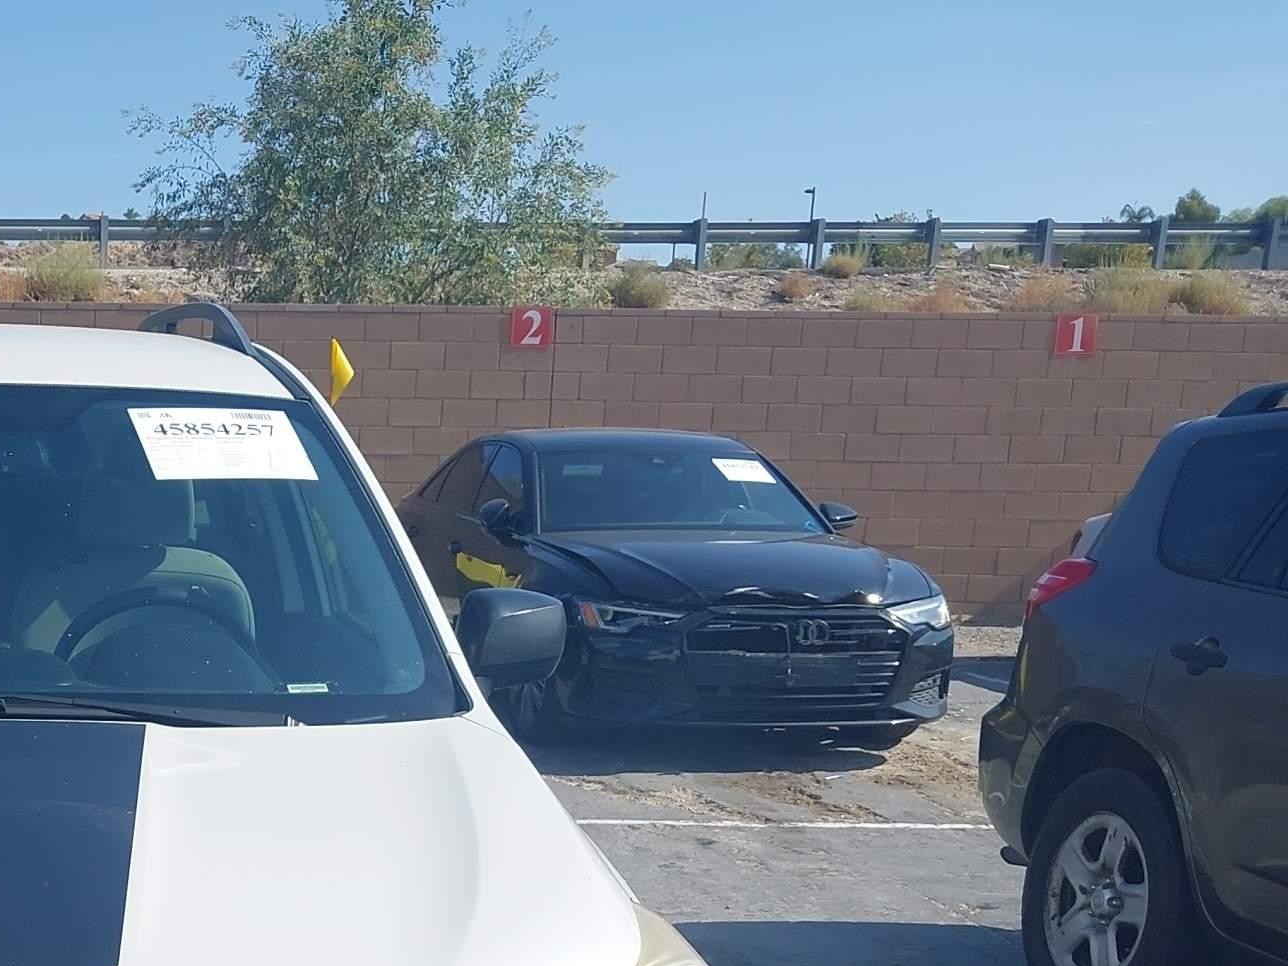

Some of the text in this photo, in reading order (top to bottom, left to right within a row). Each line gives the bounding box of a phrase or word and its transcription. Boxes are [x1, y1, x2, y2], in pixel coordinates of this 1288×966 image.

[520, 310, 542, 345] 2
[1067, 317, 1085, 352] 1
[153, 422, 274, 437] 45854257
